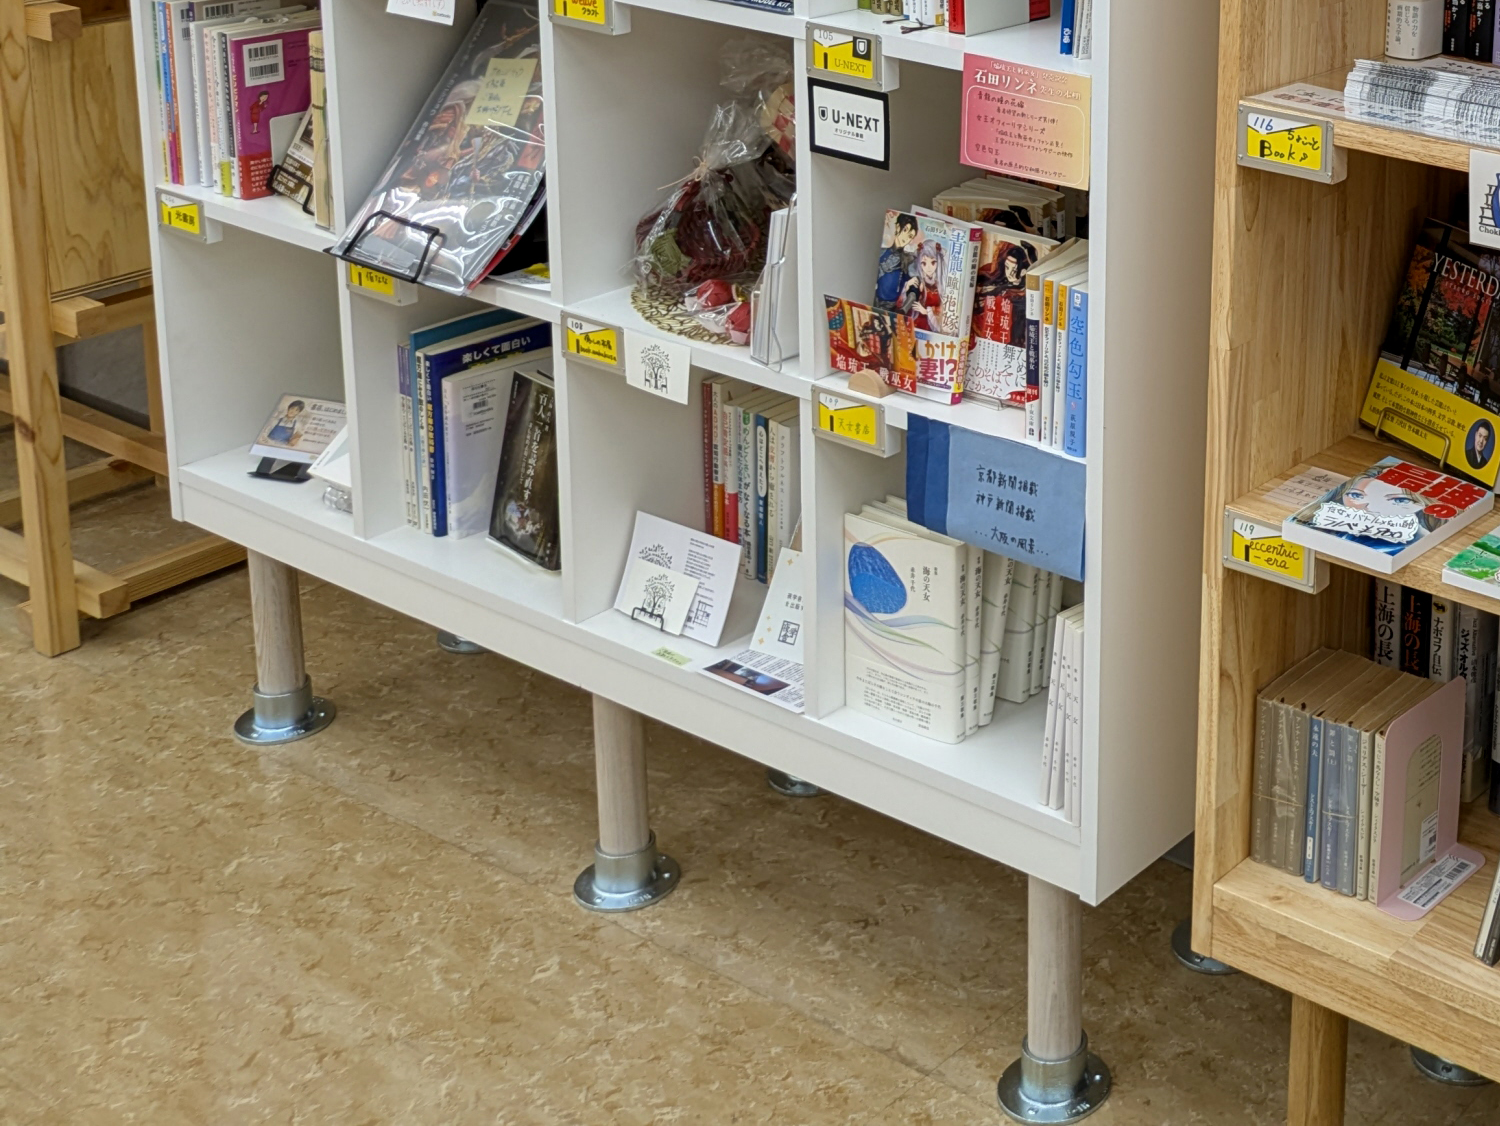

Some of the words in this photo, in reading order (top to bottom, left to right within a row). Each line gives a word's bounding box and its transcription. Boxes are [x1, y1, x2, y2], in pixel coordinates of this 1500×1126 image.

[581, 7, 599, 17] クラフト
[817, 30, 833, 42] 105
[834, 56, 867, 74] U-NEXT
[974, 67, 1037, 94] 石田リンネ
[832, 113, 880, 134] U-NEXT
[1253, 117, 1273, 132] 116
[570, 321, 584, 331] 108
[461, 335, 531, 364] 楽しくて面白い
[1068, 314, 1085, 402] 空色勾玉
[975, 462, 1040, 498] 京都新聞掲載
[975, 490, 1036, 523] 神戸新聞掲載
[1239, 522, 1255, 535] 119
[1249, 538, 1300, 561] eccentric
[921, 566, 932, 603] 海の天女
